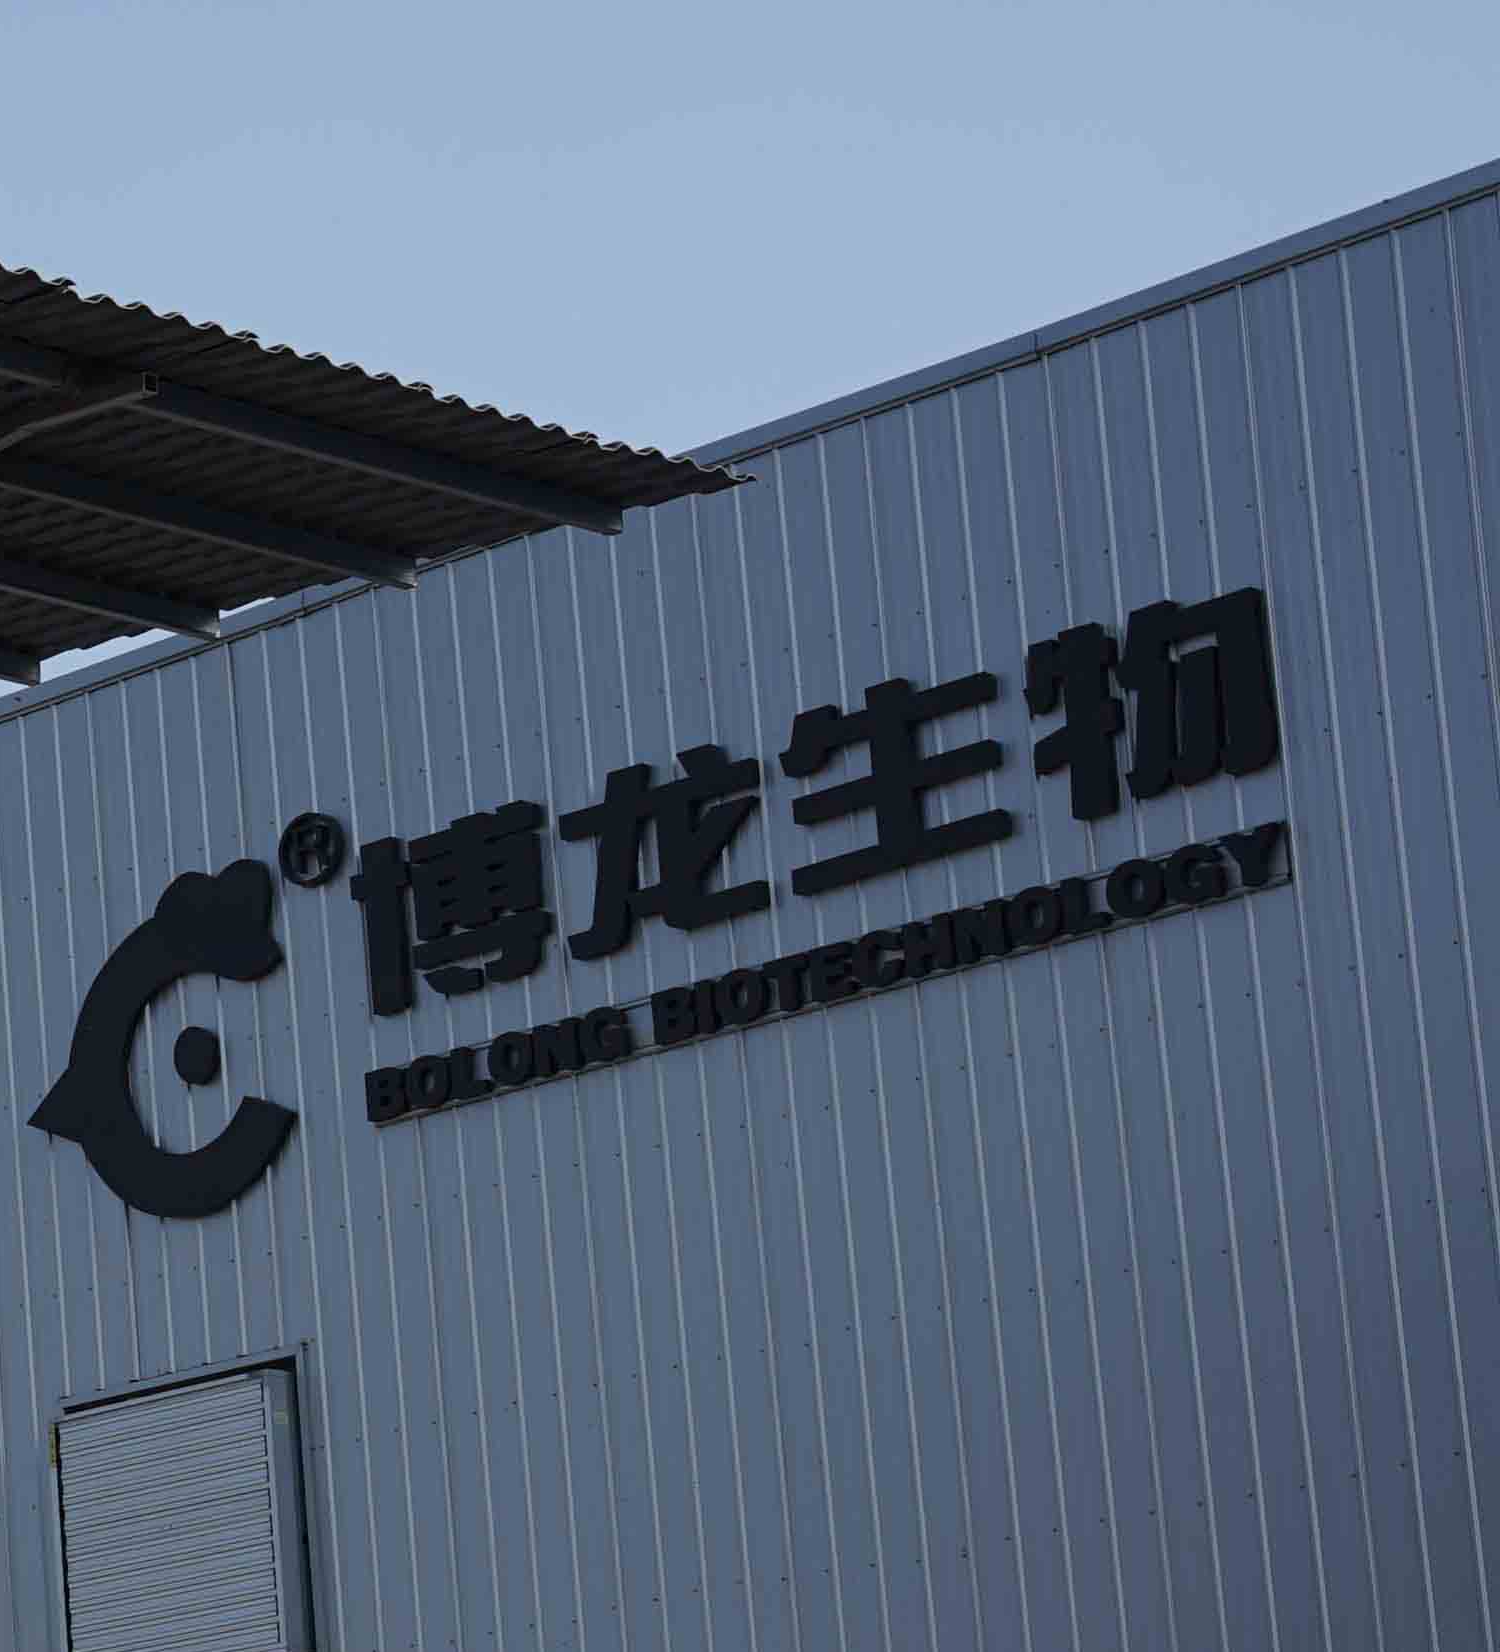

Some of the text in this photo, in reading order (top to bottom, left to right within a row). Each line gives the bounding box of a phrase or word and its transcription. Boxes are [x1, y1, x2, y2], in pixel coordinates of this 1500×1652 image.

[349, 587, 1279, 1018] 博龙生物
[364, 821, 1289, 1123] BOLONG BIOTECHNOLOGY
